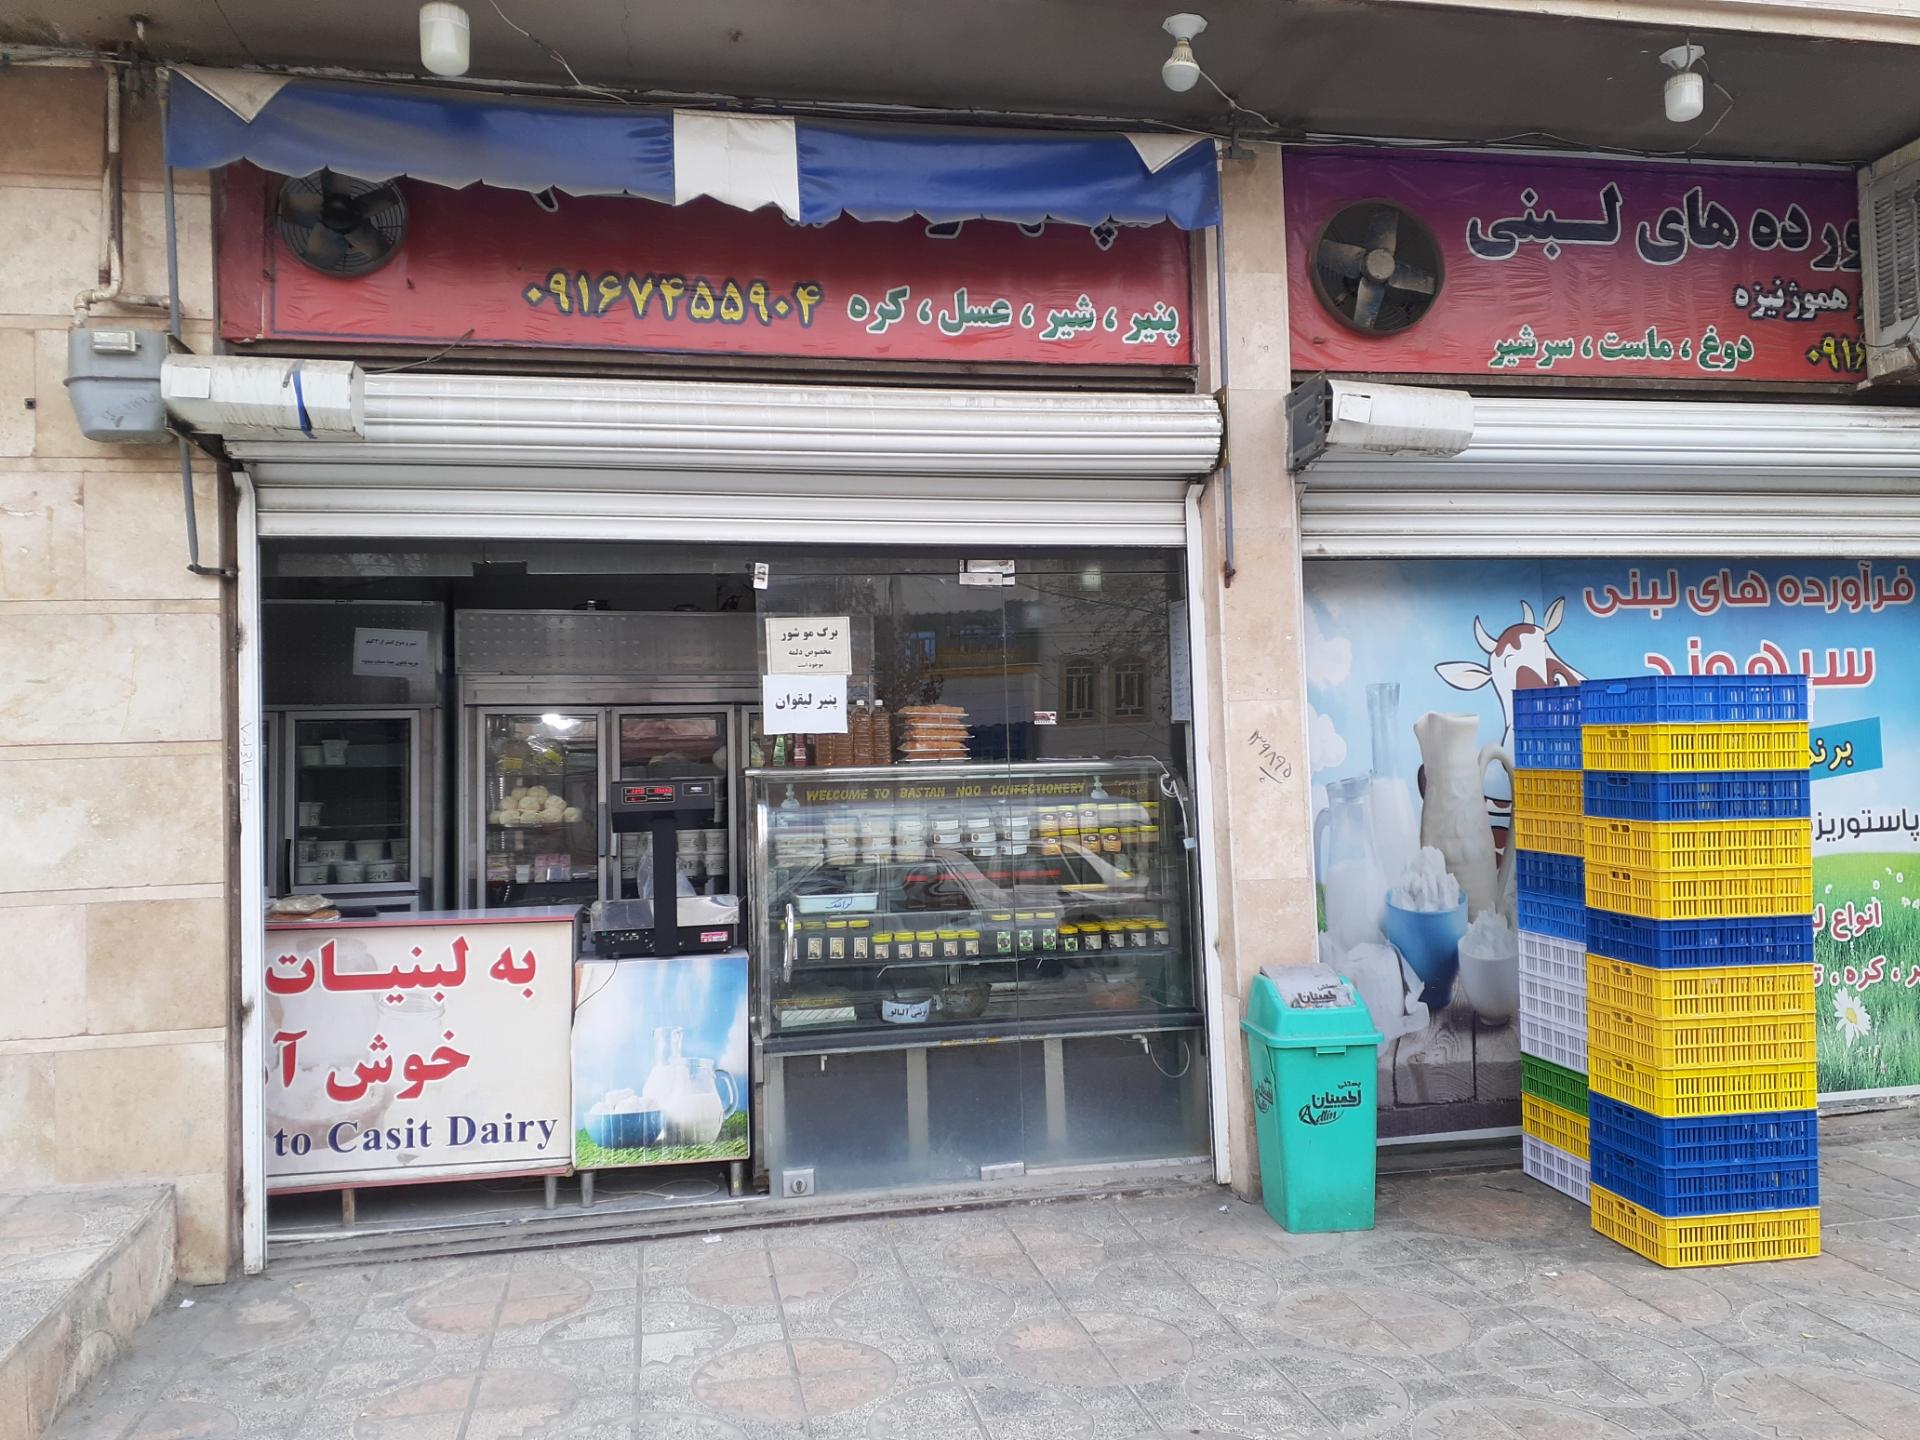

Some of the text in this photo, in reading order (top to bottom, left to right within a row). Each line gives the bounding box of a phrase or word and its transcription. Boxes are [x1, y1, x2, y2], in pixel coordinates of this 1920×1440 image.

[1636, 186, 1739, 265] های
[847, 285, 910, 334] کره
[1584, 568, 1681, 620] لبنی
[1686, 568, 1771, 616] های
[775, 692, 838, 710] پنیر لیقوان
[805, 789, 868, 801] WELCOME
[874, 788, 891, 799] TO
[1811, 808, 1920, 842] پاستوریز
[1831, 900, 1882, 941] انواع
[489, 945, 537, 999] به
[326, 1028, 471, 1102] خوش
[273, 1112, 558, 1157] to Casit Dairy
